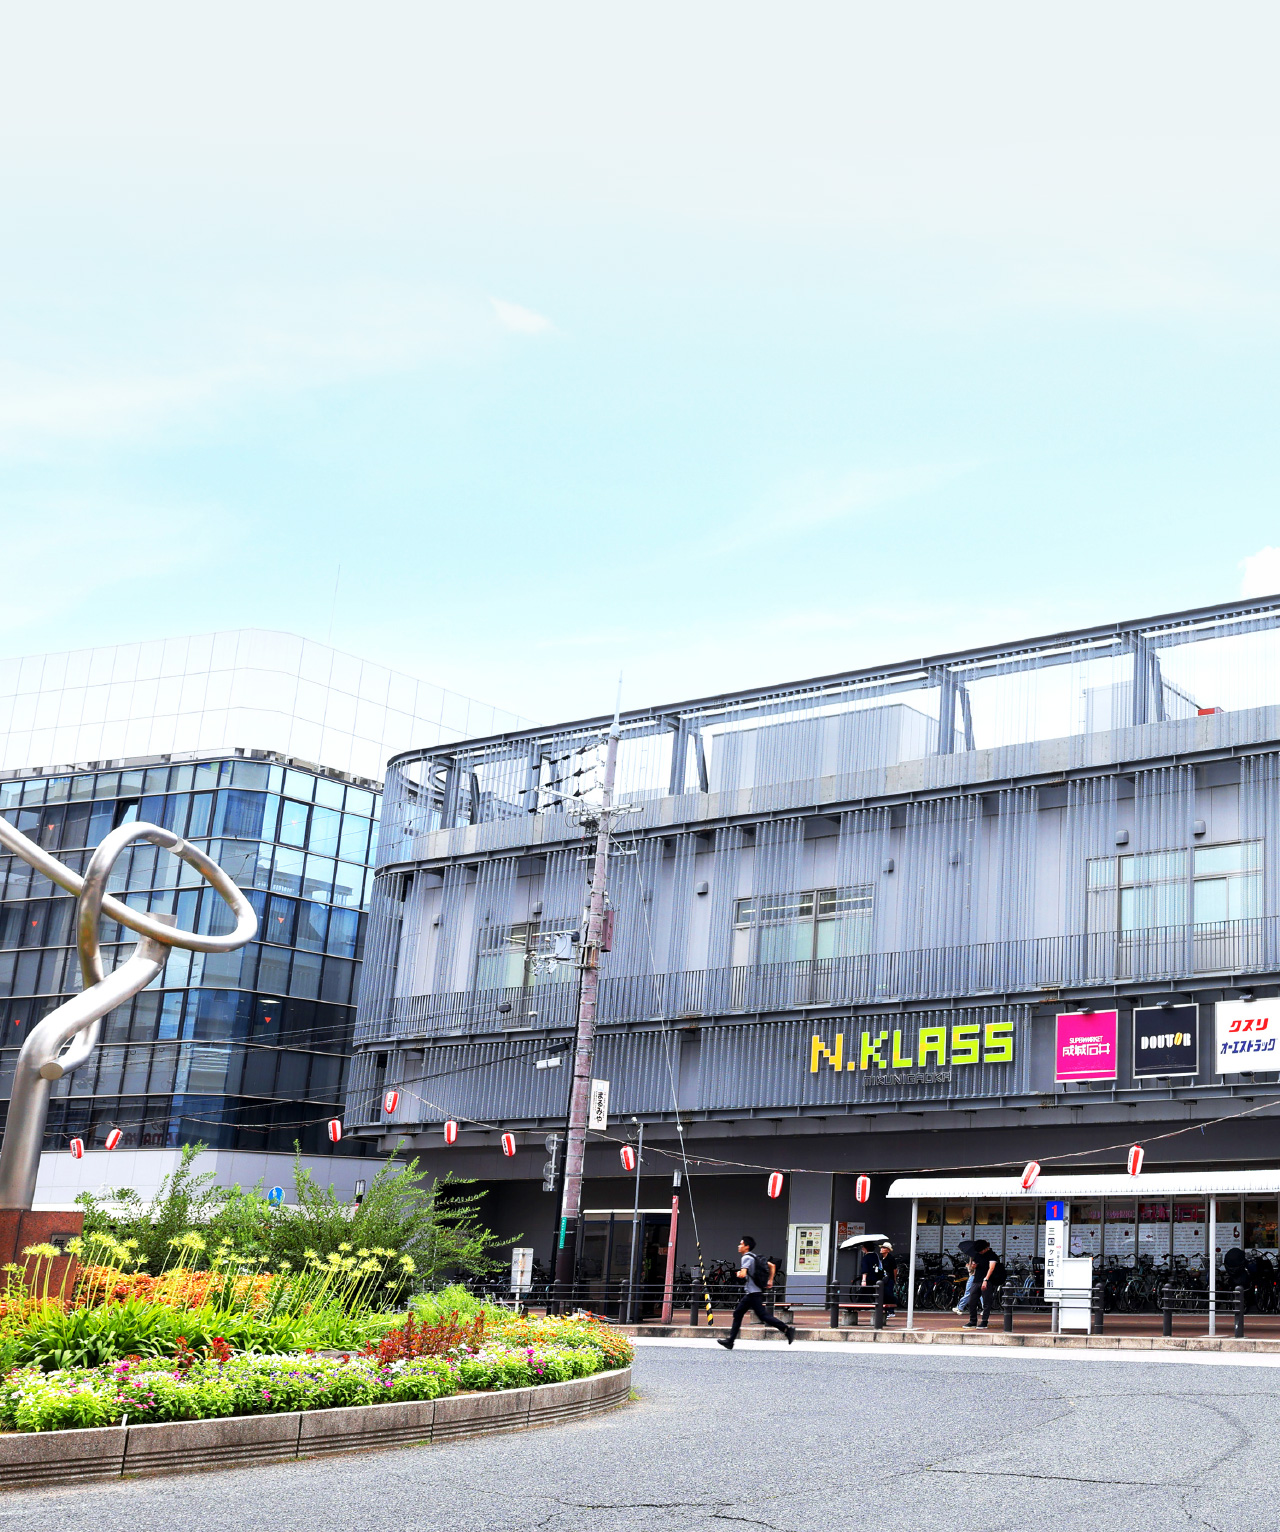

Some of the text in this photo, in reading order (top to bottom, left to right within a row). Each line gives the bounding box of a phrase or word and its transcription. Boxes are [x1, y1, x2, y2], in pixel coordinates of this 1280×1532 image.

[1228, 1017, 1269, 1033] クスリ
[810, 1021, 1014, 1073] N.KLASS
[1069, 1035, 1104, 1044] SUPERMARKET
[1140, 1032, 1191, 1050] DOUTOR
[1220, 1038, 1279, 1055] オーエスドラッグ
[1062, 1042, 1111, 1057] 成城石井
[1051, 1204, 1058, 1218] 1
[1046, 1227, 1055, 1288] 三国ヶ丘駅前
